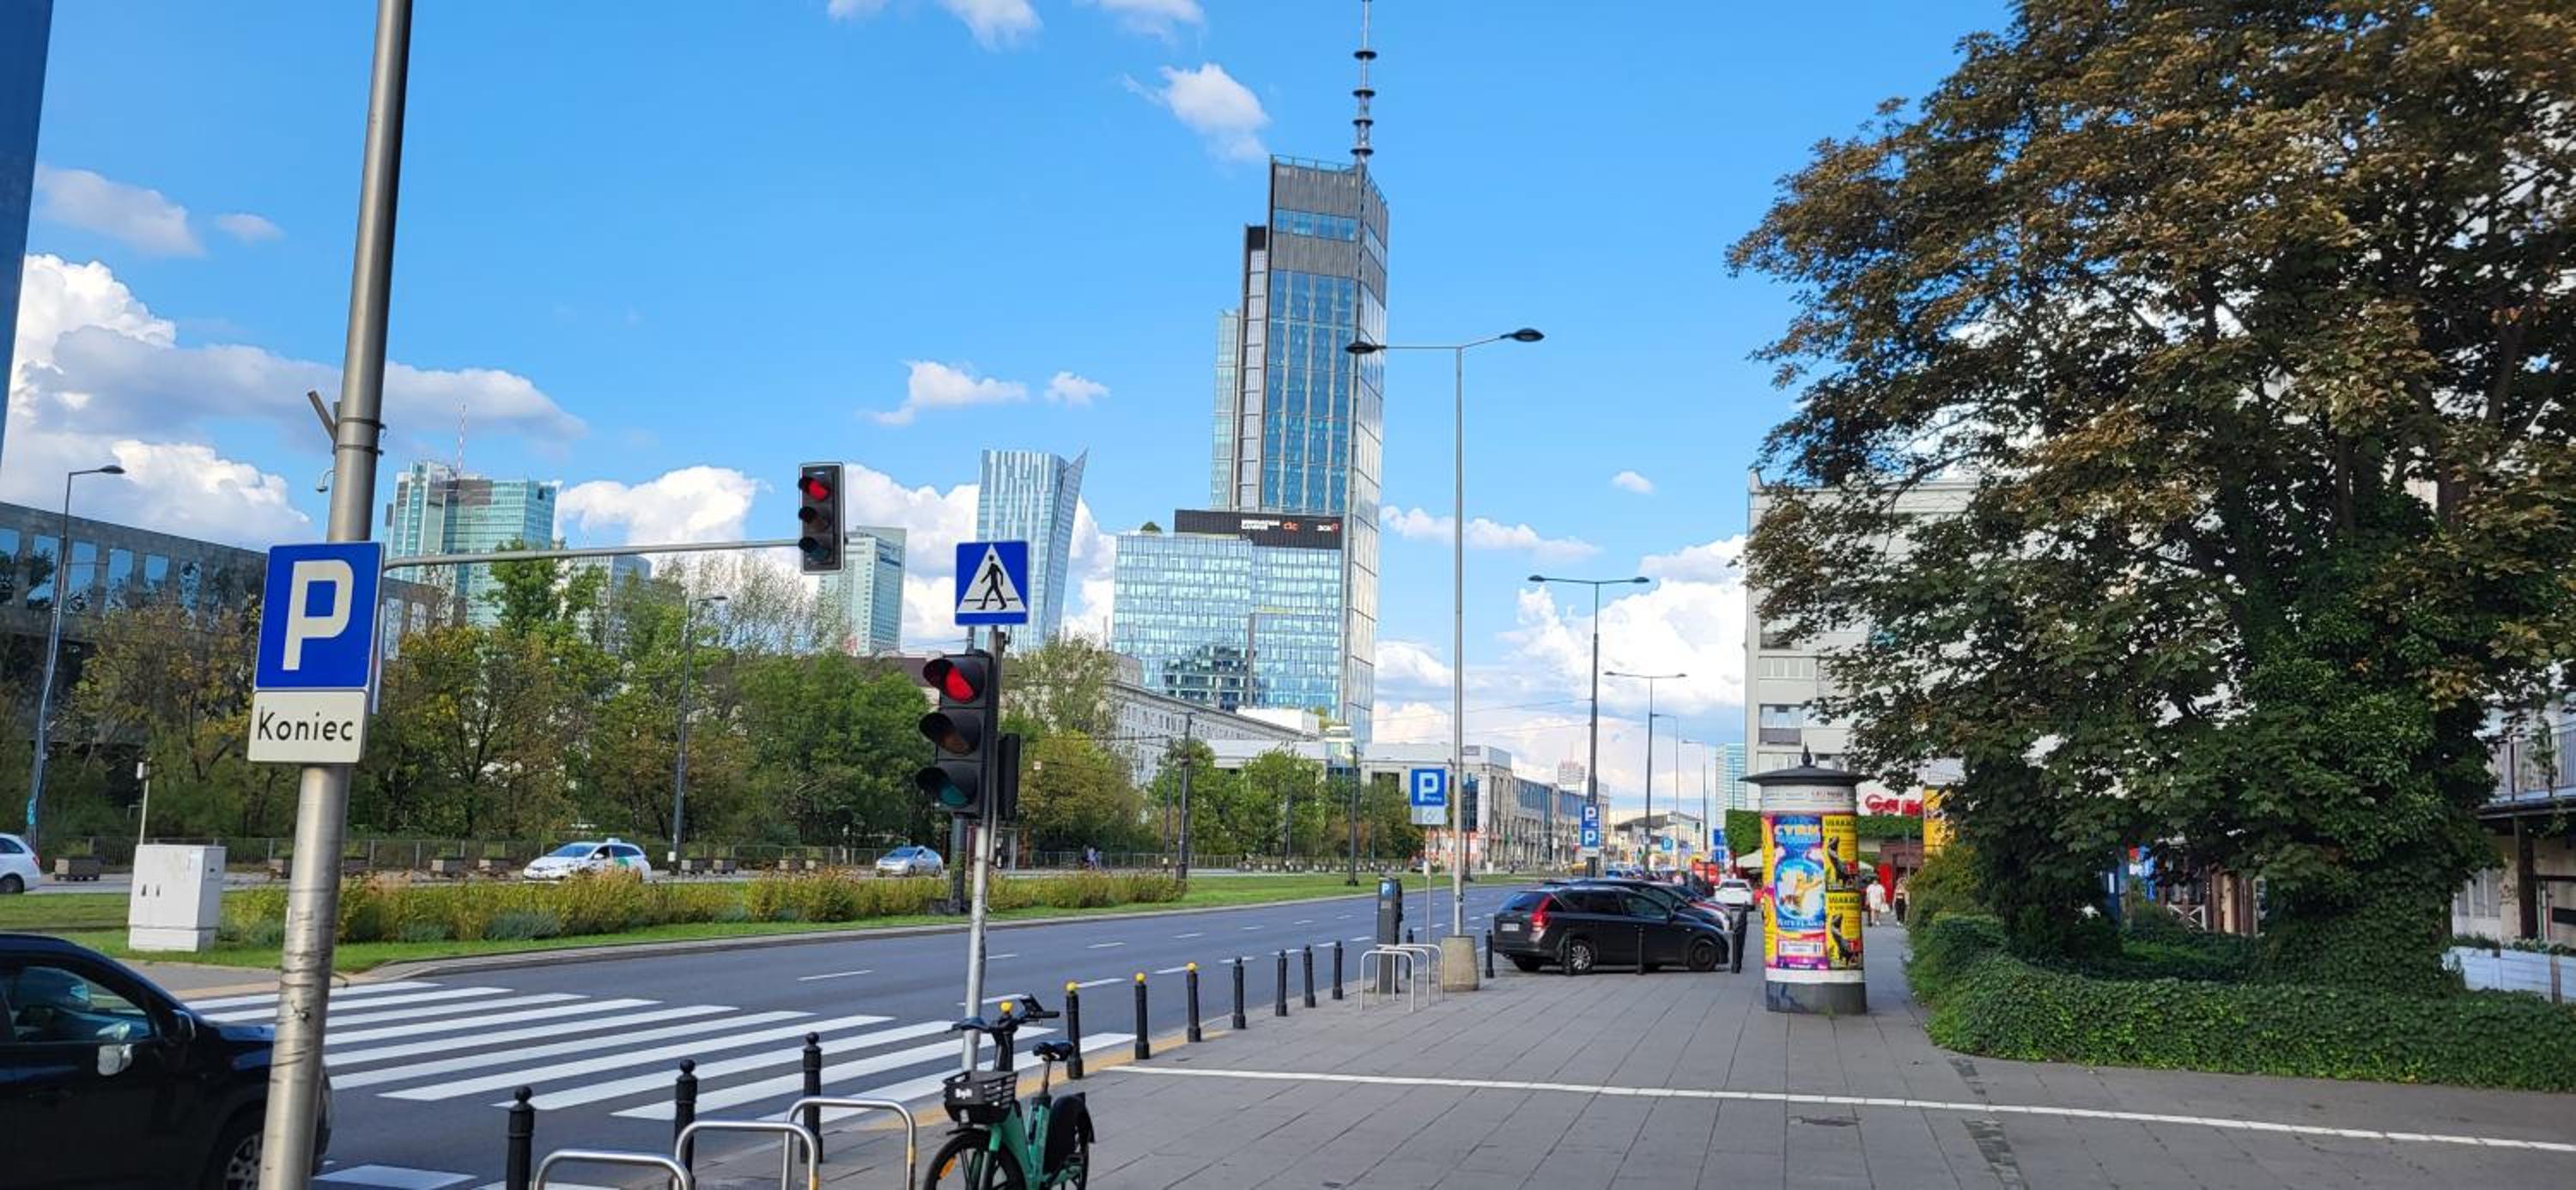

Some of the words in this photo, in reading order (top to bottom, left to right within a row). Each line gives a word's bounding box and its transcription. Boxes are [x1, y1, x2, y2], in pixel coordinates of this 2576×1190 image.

[283, 559, 354, 671] P
[258, 708, 354, 741] Koniec
[1419, 772, 1438, 802] P
[1584, 806, 1597, 822] P
[1584, 830, 1597, 846] P
[1381, 882, 1390, 894] P
